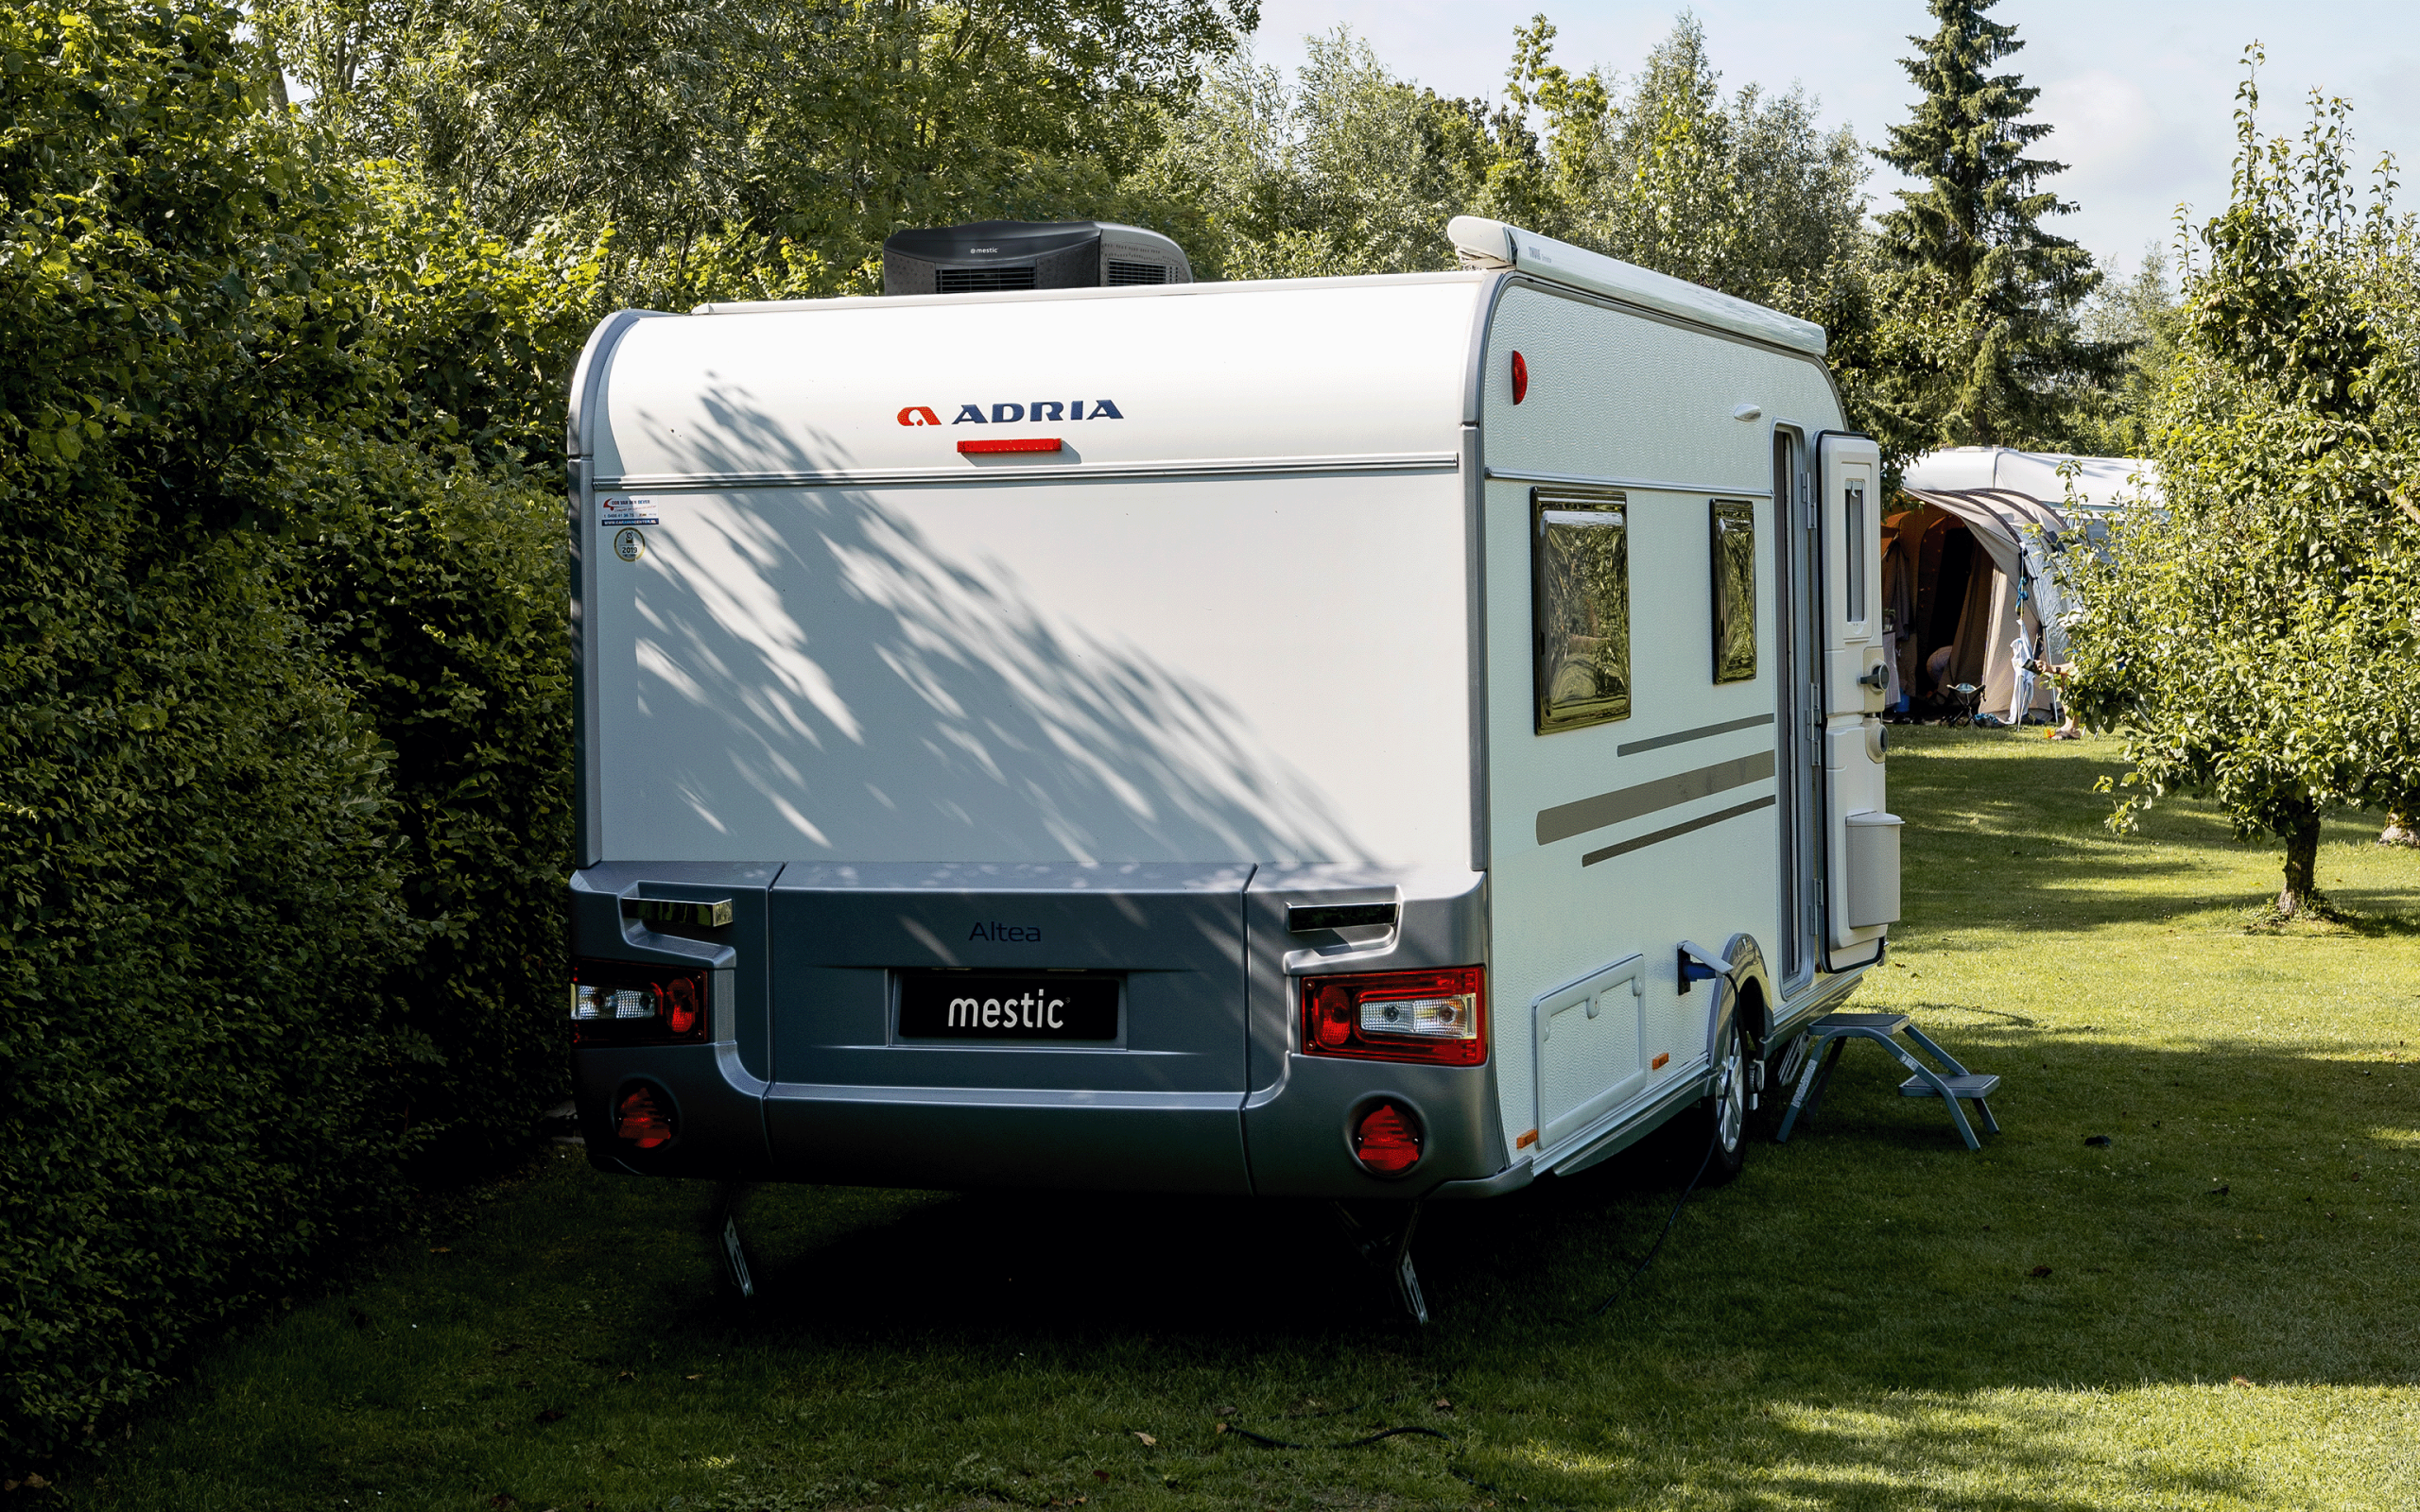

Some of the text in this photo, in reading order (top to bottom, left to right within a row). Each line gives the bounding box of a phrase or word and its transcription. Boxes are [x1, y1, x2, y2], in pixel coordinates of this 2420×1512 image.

[951, 399, 1124, 425] ADRIA
[969, 921, 1042, 942] Altea
[947, 988, 1065, 1029] mestic
